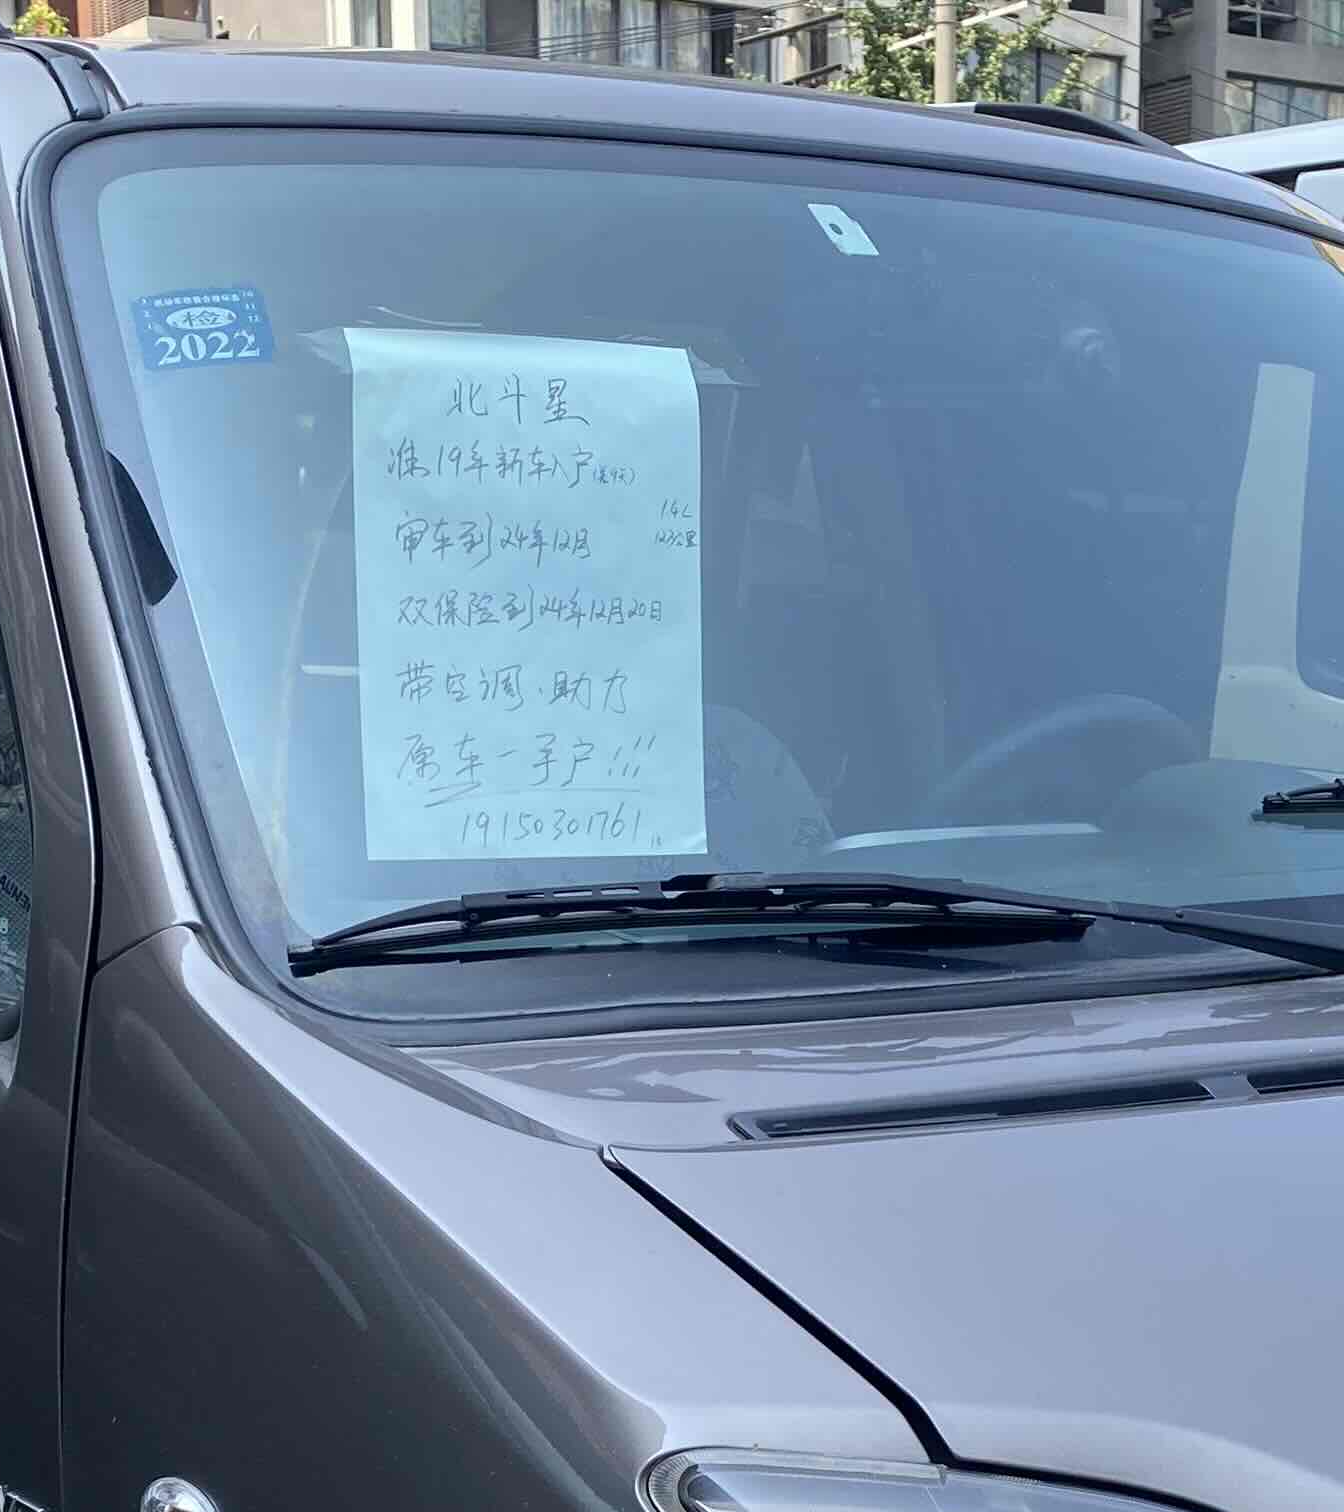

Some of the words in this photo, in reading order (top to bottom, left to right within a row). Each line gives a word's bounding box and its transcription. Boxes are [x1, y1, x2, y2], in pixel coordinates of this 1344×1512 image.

[155, 330, 261, 367] 2022
[446, 373, 591, 426] 北斗星
[461, 801, 642, 848] 19150301761
